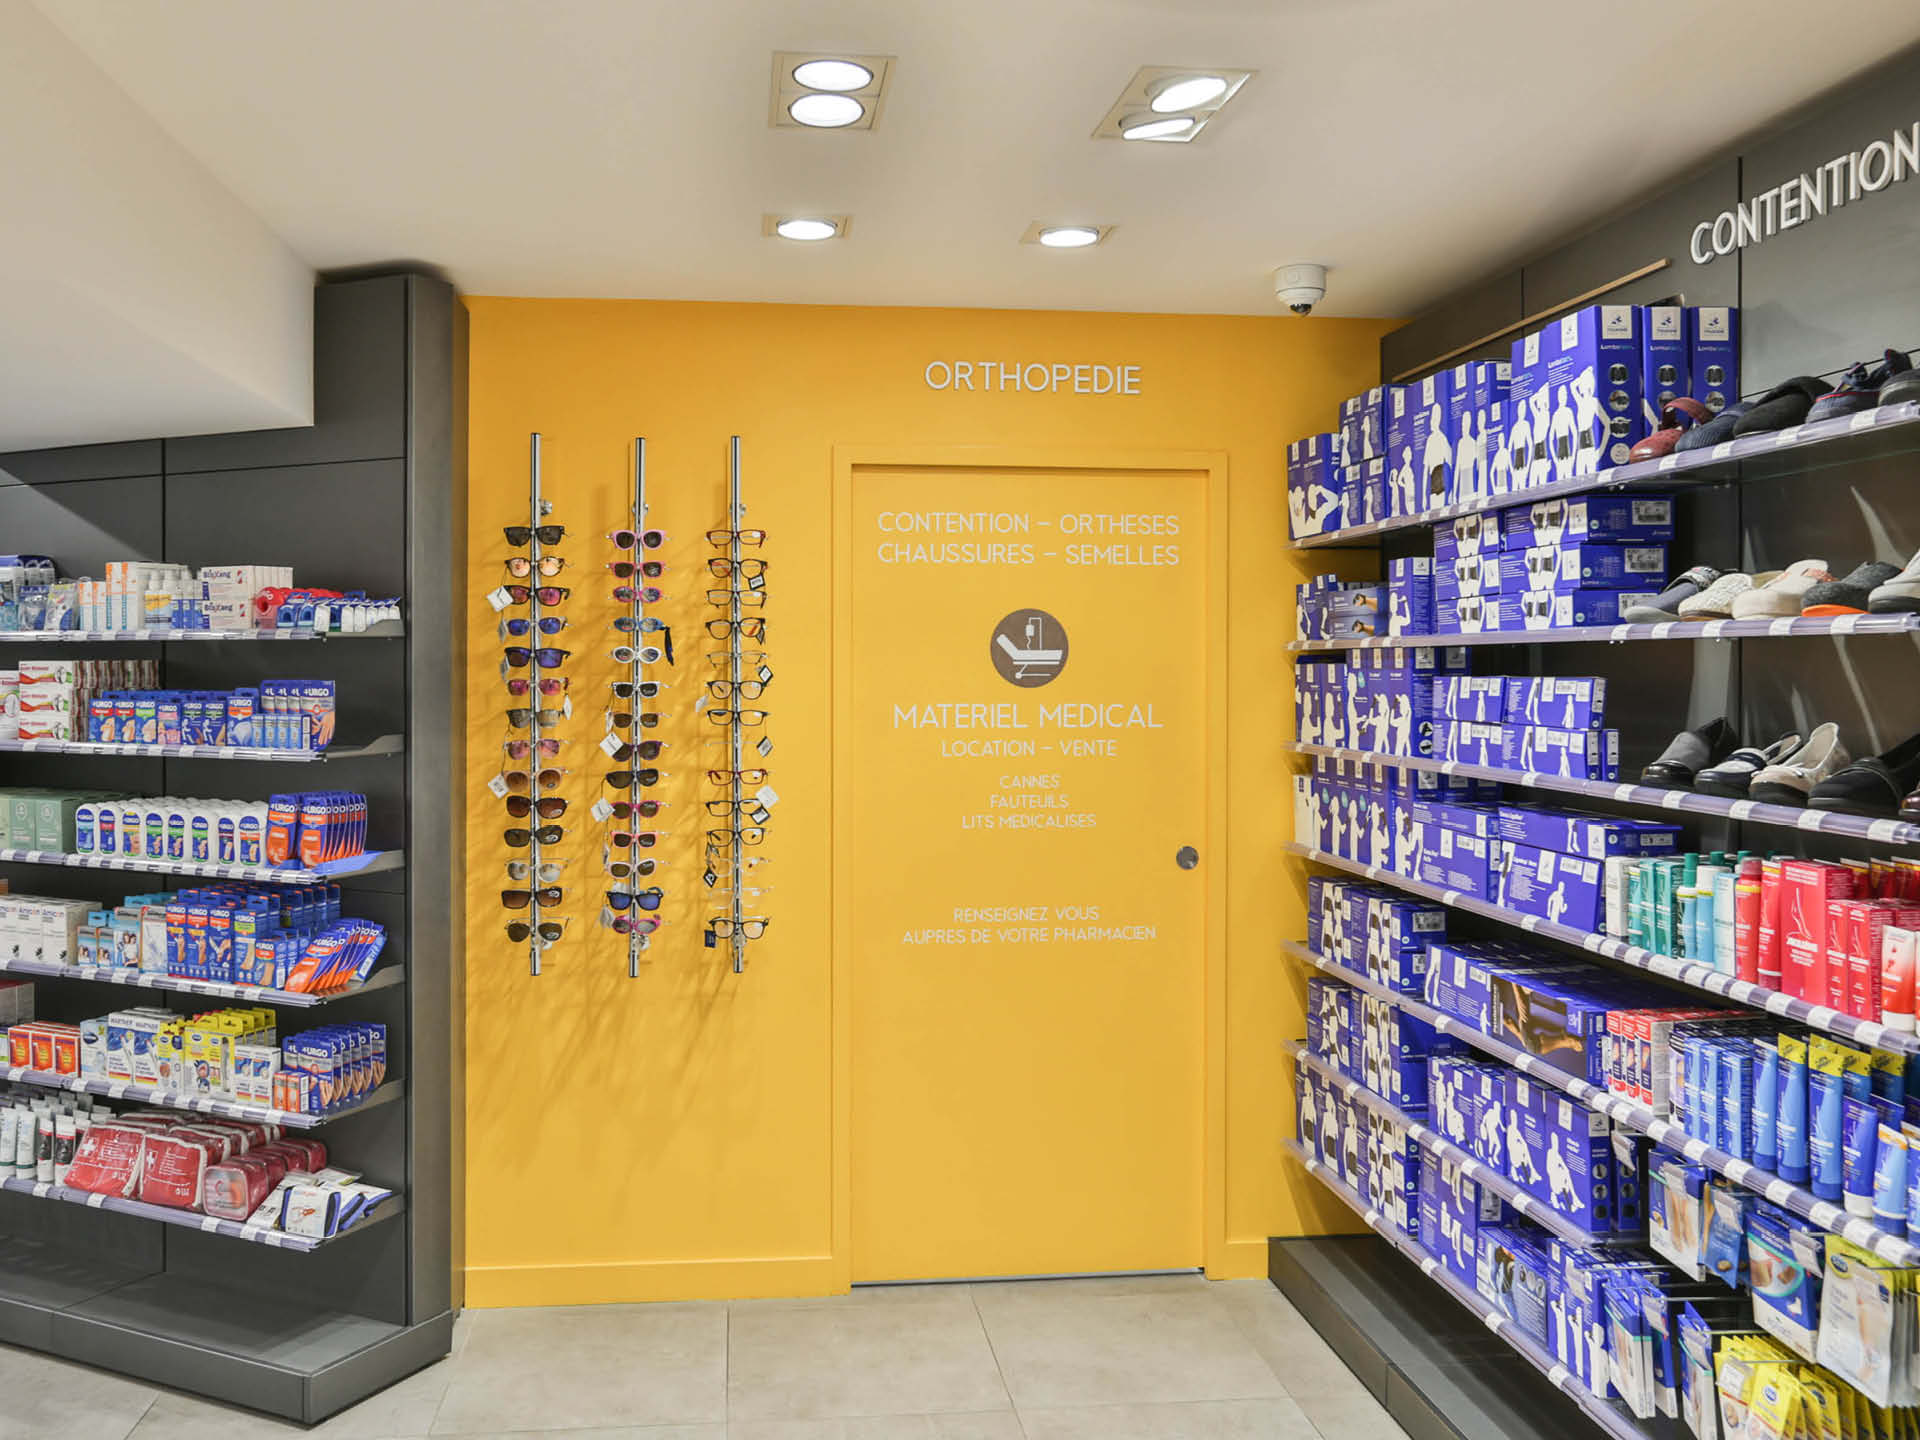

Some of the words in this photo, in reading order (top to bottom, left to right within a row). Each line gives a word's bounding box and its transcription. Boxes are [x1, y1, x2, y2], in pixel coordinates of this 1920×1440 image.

[1690, 121, 1920, 264] CONTENTION
[924, 360, 1142, 395] ORTHOPEDIE
[877, 511, 1030, 534] CONTENTION
[1059, 513, 1180, 536] ORTHESES
[877, 542, 1036, 565] CHAUSSURES
[1065, 543, 1180, 566] SEMELLES
[309, 688, 329, 697] URGO
[893, 703, 1029, 729] MATERIEL
[1038, 703, 1165, 729] MEDICAL
[941, 740, 1036, 757] LOCATION
[1059, 739, 1118, 757] VENTE
[999, 774, 1061, 790] CANNES
[276, 803, 295, 813] URGO
[989, 794, 1070, 809] FAUTEUILS
[307, 806, 326, 815] URGO
[961, 814, 995, 829] LITS
[998, 813, 1097, 829] MEDICALISES
[953, 906, 1049, 922] RENSEIGNEZ
[1055, 905, 1100, 921] VOUS
[317, 937, 338, 947] URGO
[902, 929, 967, 945] AUPRES
[970, 928, 993, 944] DE
[996, 927, 1050, 943] VOTRE
[1053, 926, 1157, 942] PHARMACIEN
[306, 1047, 328, 1058] URGO
